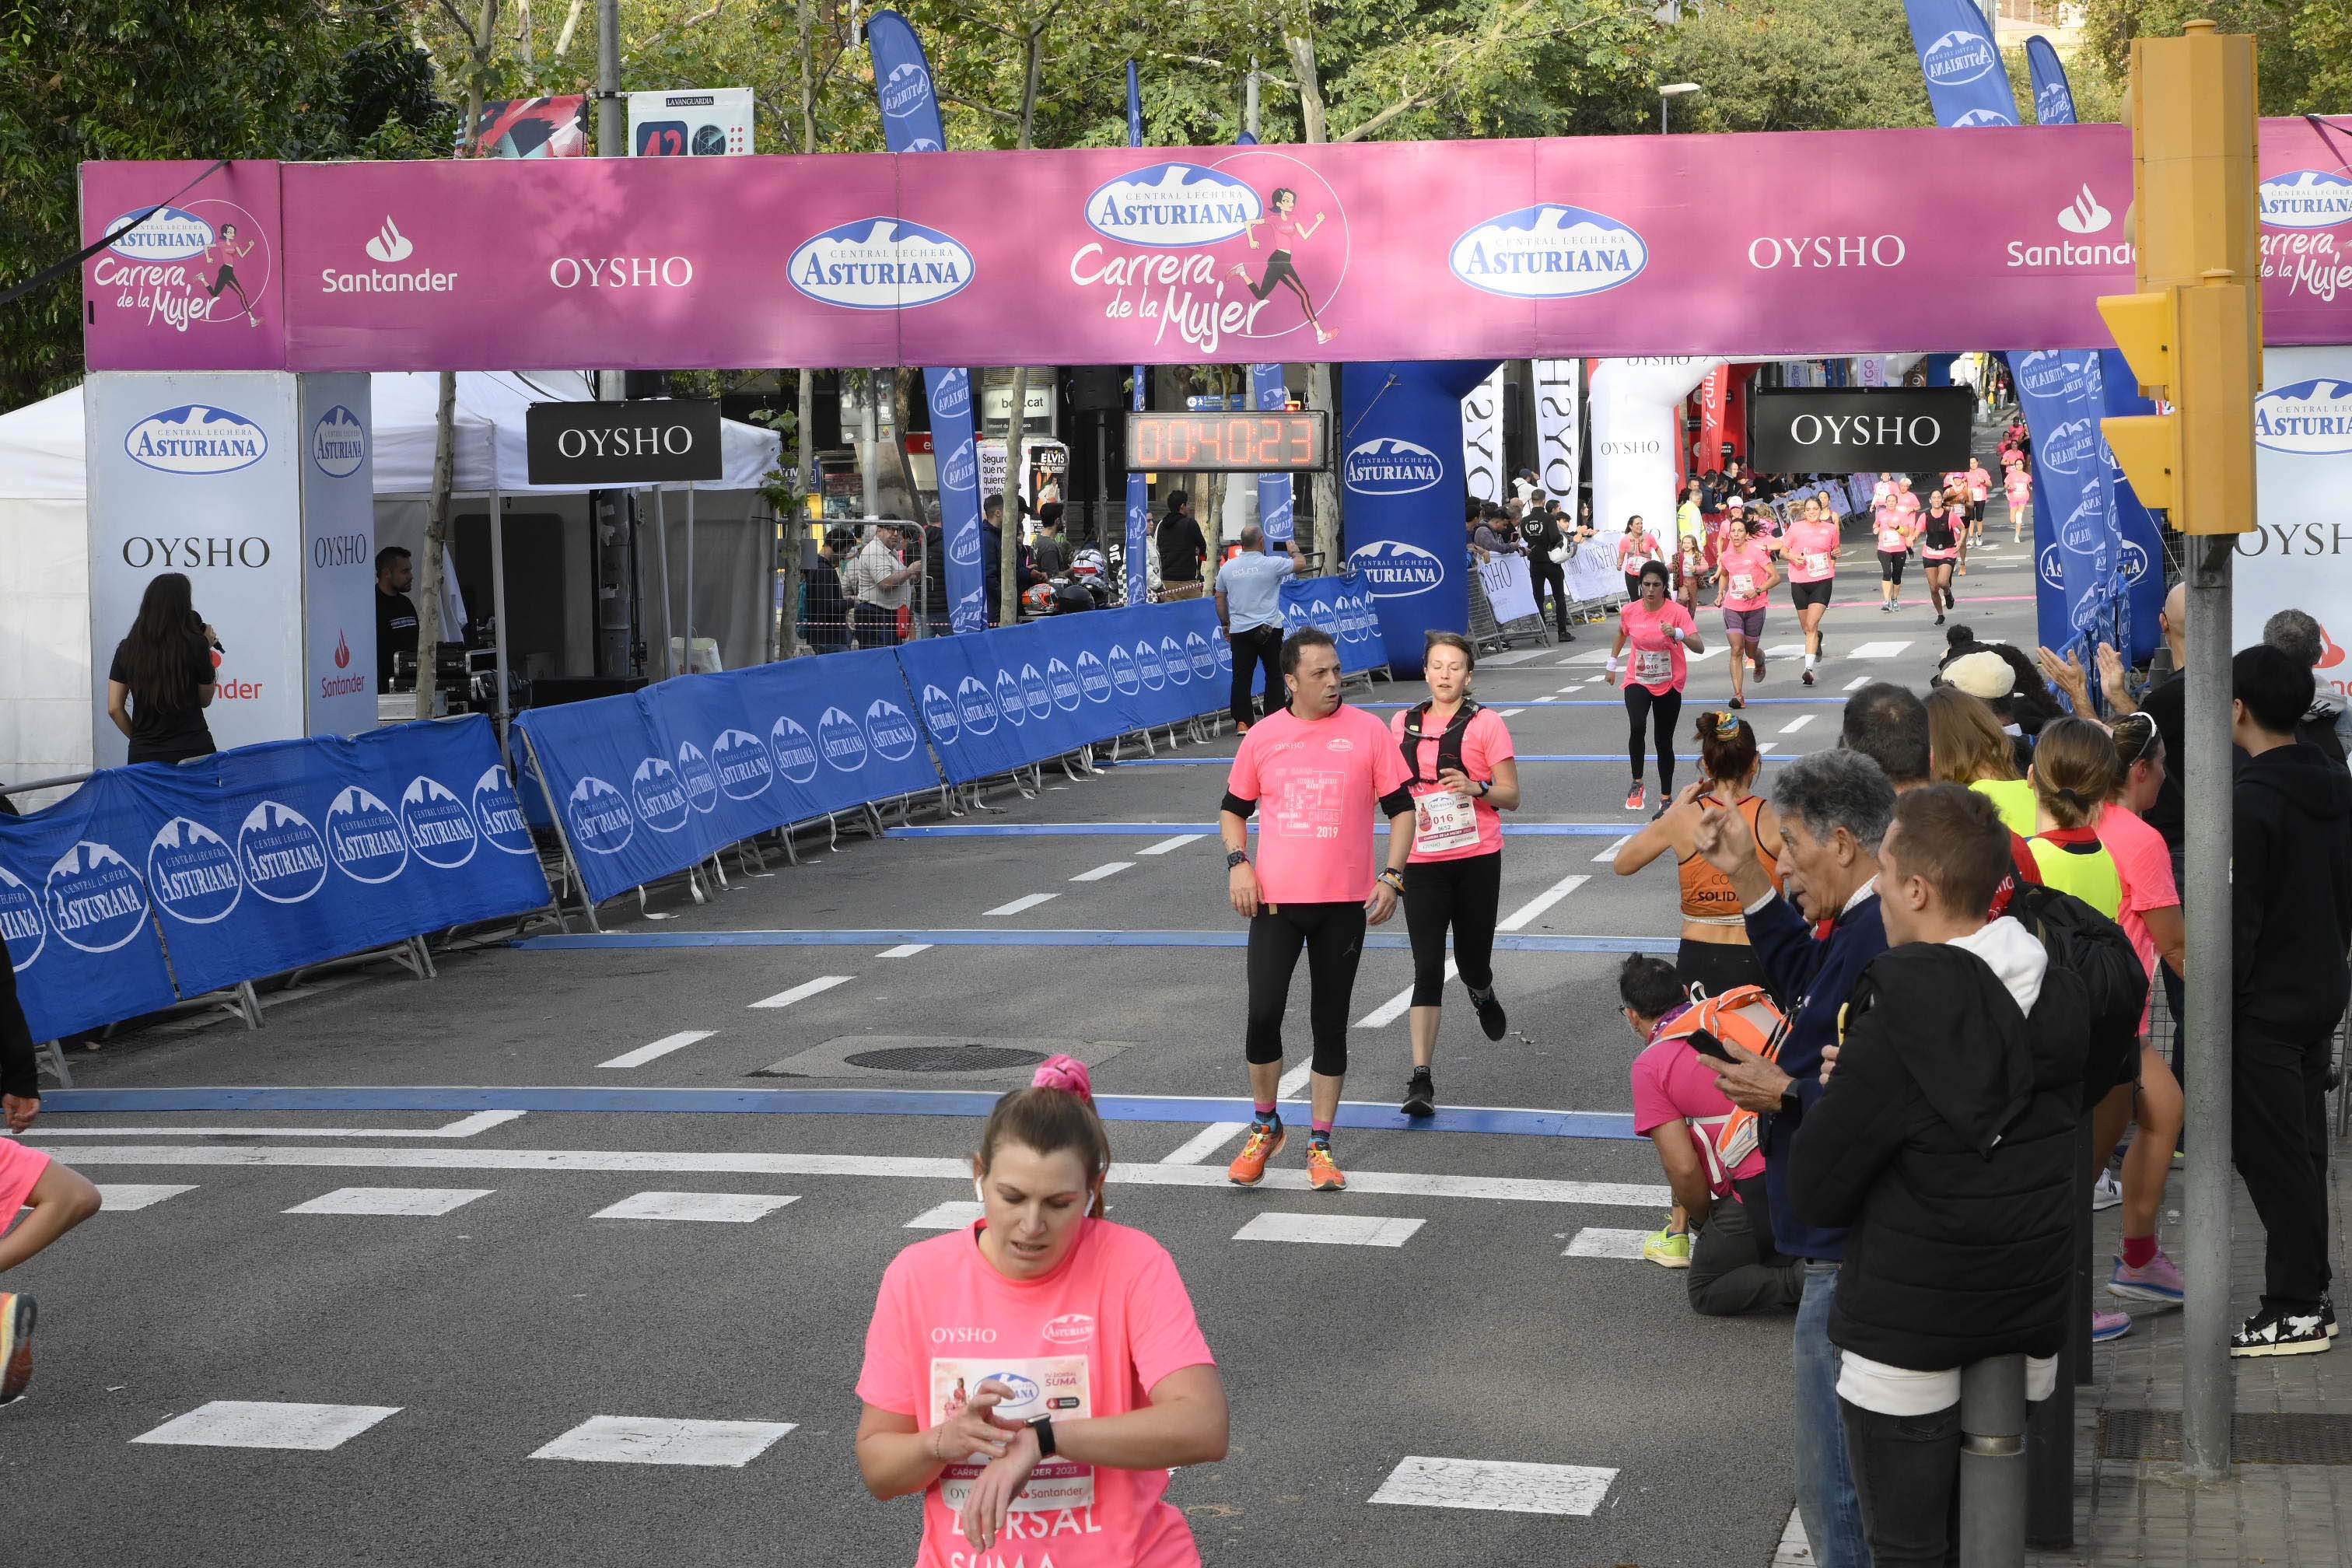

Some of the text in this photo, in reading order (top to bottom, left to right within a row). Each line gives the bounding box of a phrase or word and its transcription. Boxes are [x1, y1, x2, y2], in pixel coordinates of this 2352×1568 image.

[675, 97, 713, 106] VANGUARDIA
[1125, 191, 1244, 201] CENTRAL LECHERA
[1098, 194, 1248, 227] ASTURIANA
[112, 226, 206, 247] ASTURIANA
[1495, 235, 1626, 247] CENTRAL LECHERA
[2260, 233, 2335, 255] arrera
[831, 248, 955, 259] CENTRAL LECHERA
[1069, 242, 1216, 286] Carrera
[1465, 241, 1632, 275] ASTURIANA
[1748, 234, 1906, 269] OYSHO
[94, 257, 186, 286] Carrera
[321, 268, 458, 292] Santander
[550, 256, 693, 289] OYSHO
[801, 252, 961, 286] ASTURIANA
[2277, 256, 2292, 278] la
[2289, 251, 2352, 302] Muje
[117, 283, 221, 332] de la Mujer
[1106, 281, 1270, 354] de la Mujer
[2277, 405, 2329, 414] CENTRAL
[157, 429, 204, 437] CENTRAL
[558, 425, 693, 458] OYSHO
[1138, 419, 1313, 464] 00:40:23
[1790, 414, 1941, 446] OYSHO
[136, 430, 257, 458] ASTURIANA
[317, 431, 363, 460] ASTURIANA
[1601, 440, 1660, 456] OYSHO
[1041, 453, 1065, 464] ELVIS
[1348, 461, 1436, 482] ASTURIANA
[122, 537, 271, 568] OYSHO
[315, 533, 367, 569] OYSHO
[2234, 522, 2352, 558] OYSH
[1352, 562, 1436, 583] TURIANA
[1481, 559, 1512, 594] YSHO
[321, 672, 366, 699] Santander
[775, 744, 815, 769] ASTURIANA
[823, 733, 865, 758] ASTURIANA
[1276, 740, 1304, 751] OYSHO
[716, 757, 772, 786] ASTURIANA
[407, 814, 474, 849] ASTURIANA
[1317, 826, 1339, 838] 2019
[1433, 814, 1454, 824] 016
[334, 825, 404, 863] ASTURIANA
[246, 843, 324, 883] ASTURIANA
[156, 861, 238, 904] ASTURIANA
[1712, 873, 1729, 885] CO
[1699, 891, 1738, 901] SOLID
[931, 1327, 996, 1343] OYSHO
[1045, 1377, 1077, 1387] SUMA
[952, 1467, 983, 1476] CARRE
[1055, 1466, 1078, 1475] 2023
[1031, 1486, 1083, 1499] Santander
